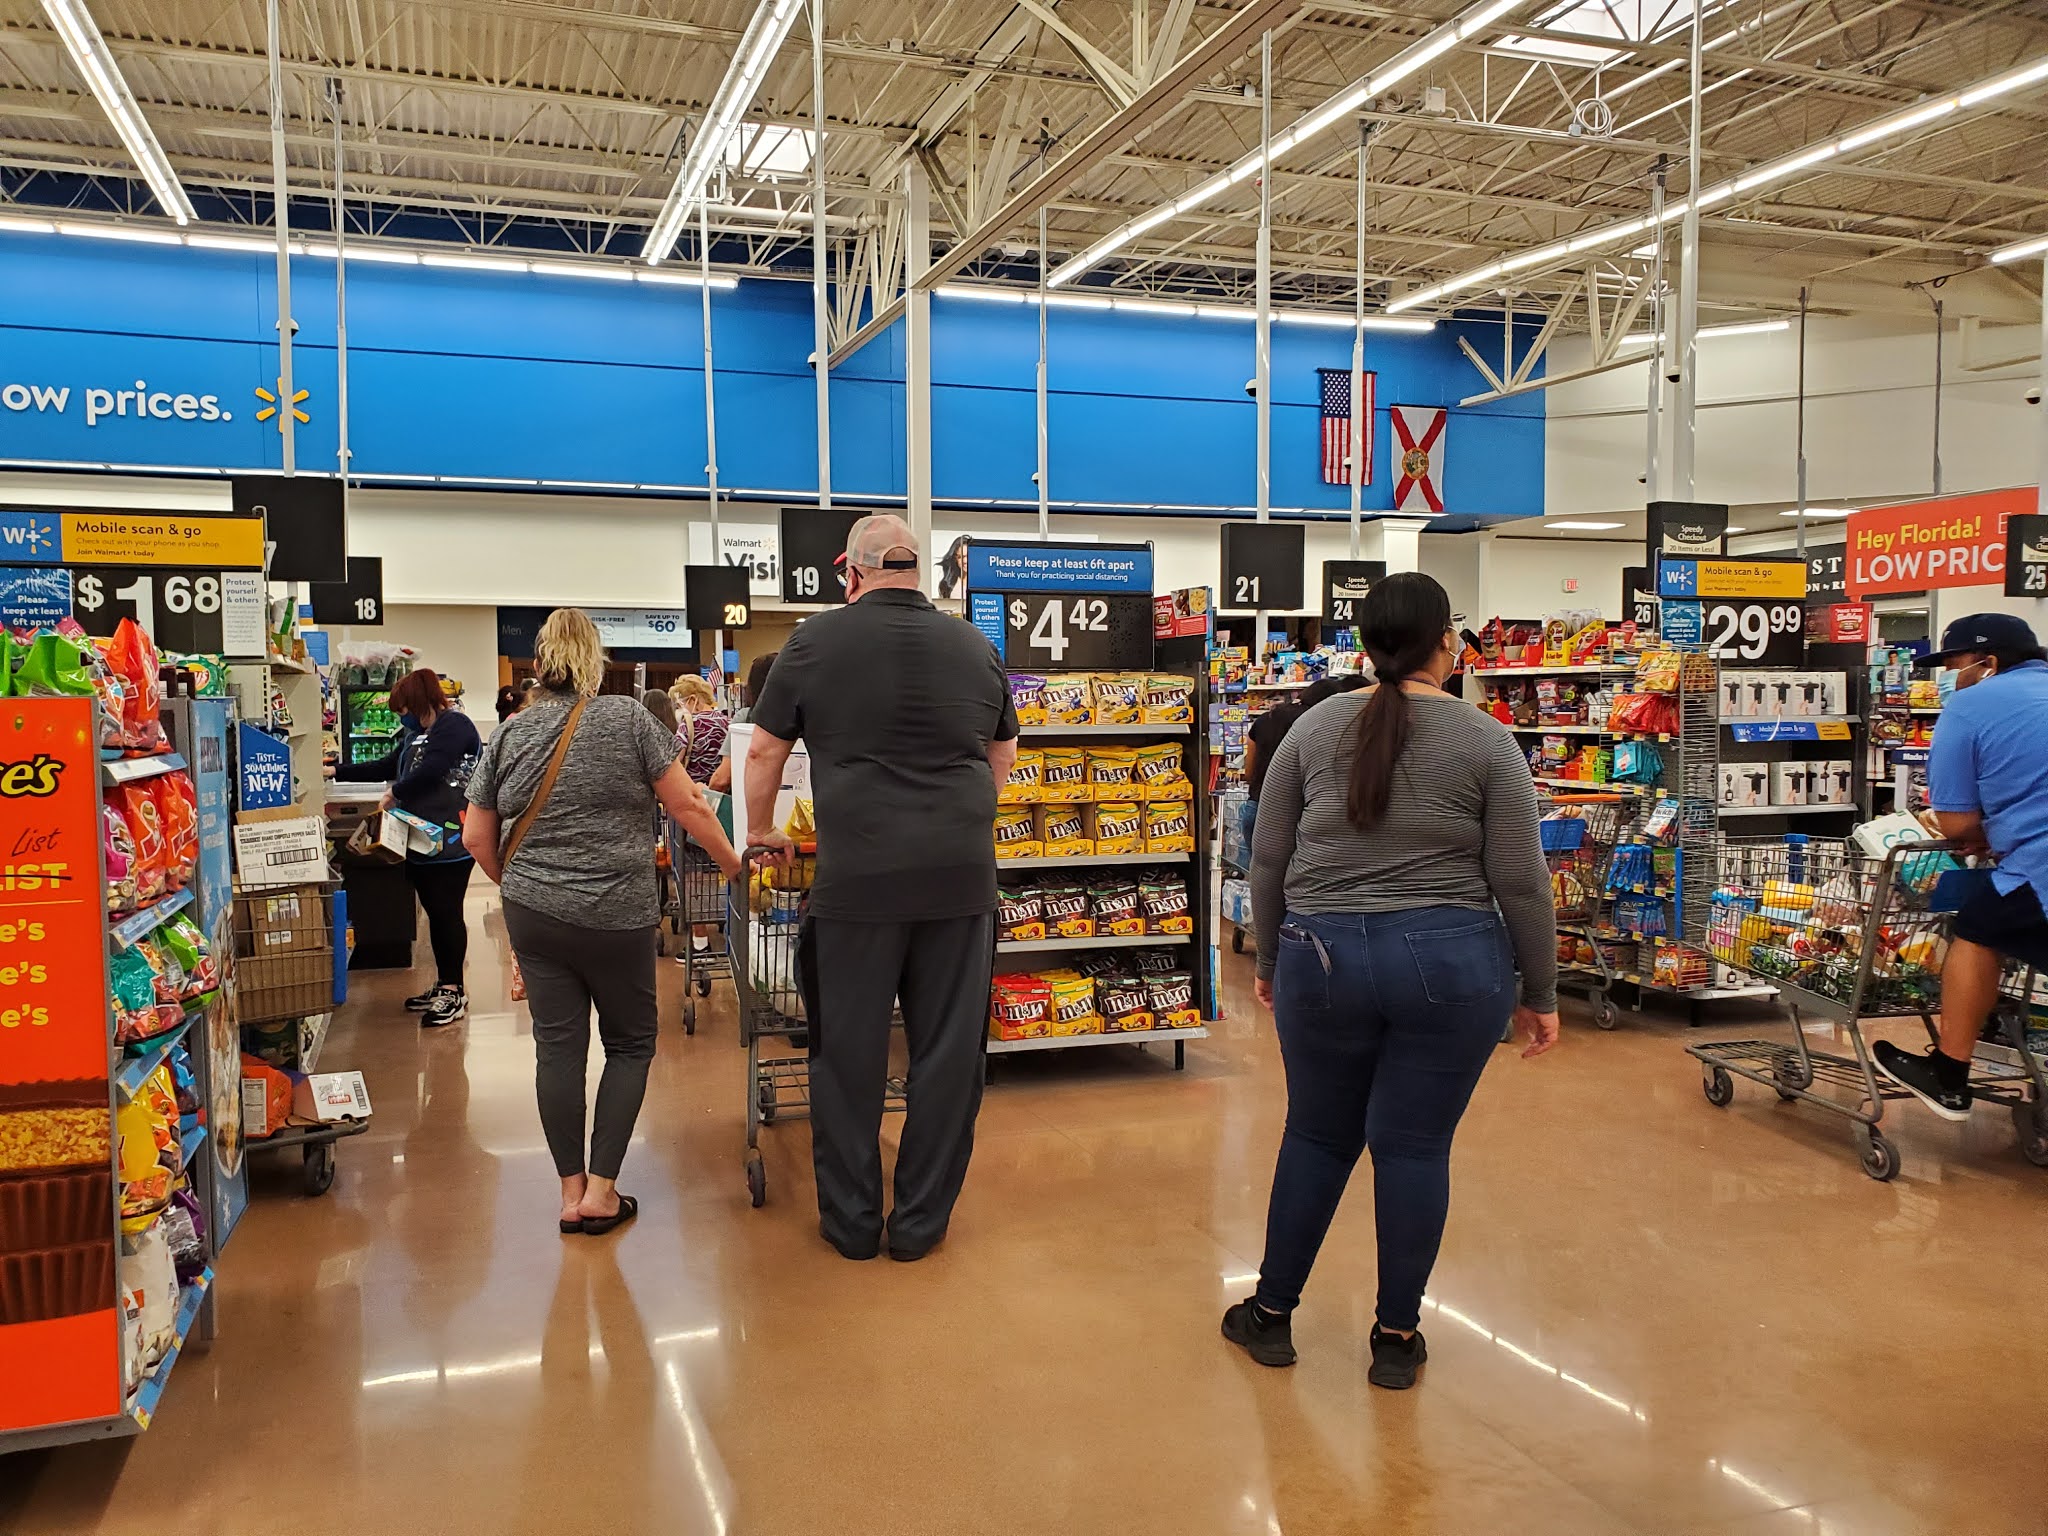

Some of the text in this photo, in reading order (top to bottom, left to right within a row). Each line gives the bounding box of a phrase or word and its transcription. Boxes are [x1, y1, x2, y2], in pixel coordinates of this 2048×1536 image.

[86, 380, 233, 426] prices.
[76, 521, 202, 538] Mobile scan & go
[1677, 533, 1707, 541] Checkout
[1681, 524, 1704, 534] Speedy
[1857, 515, 1982, 552] Hey Florida!
[723, 538, 761, 548] Walmart
[724, 552, 780, 580] Visi
[989, 555, 1134, 573] Please keep at least 6ft apart
[1704, 567, 1732, 575] Mobile
[1754, 567, 1760, 576] &
[1762, 569, 1773, 578] go
[1855, 543, 2005, 584] LOW PRIC
[226, 578, 255, 586] Protect
[792, 566, 820, 596] 19
[996, 570, 1128, 583] Thank you for practicing social distancing
[1566, 579, 1577, 590] EXIT
[2024, 565, 2047, 590] 25
[78, 574, 105, 612] $
[164, 576, 221, 614] 68
[1235, 576, 1260, 603] 21
[17, 595, 48, 604] Please
[974, 598, 997, 606] Protect
[2, 607, 26, 616] keep
[41, 607, 63, 615] least
[354, 598, 377, 620] 18
[724, 604, 747, 625] 20
[1333, 600, 1353, 620] 24
[1634, 604, 1651, 623] 26
[12, 618, 28, 626] 6ft
[501, 624, 522, 636] Men
[1009, 598, 1028, 631] $
[1029, 599, 1069, 661] 4
[1068, 599, 1109, 632] 42
[1708, 604, 1770, 660] 29
[1770, 605, 1801, 633] 99
[255, 752, 276, 763] TASTE
[244, 763, 288, 774] SOMETHING
[247, 773, 286, 792] NEW
[11, 827, 62, 857] List
